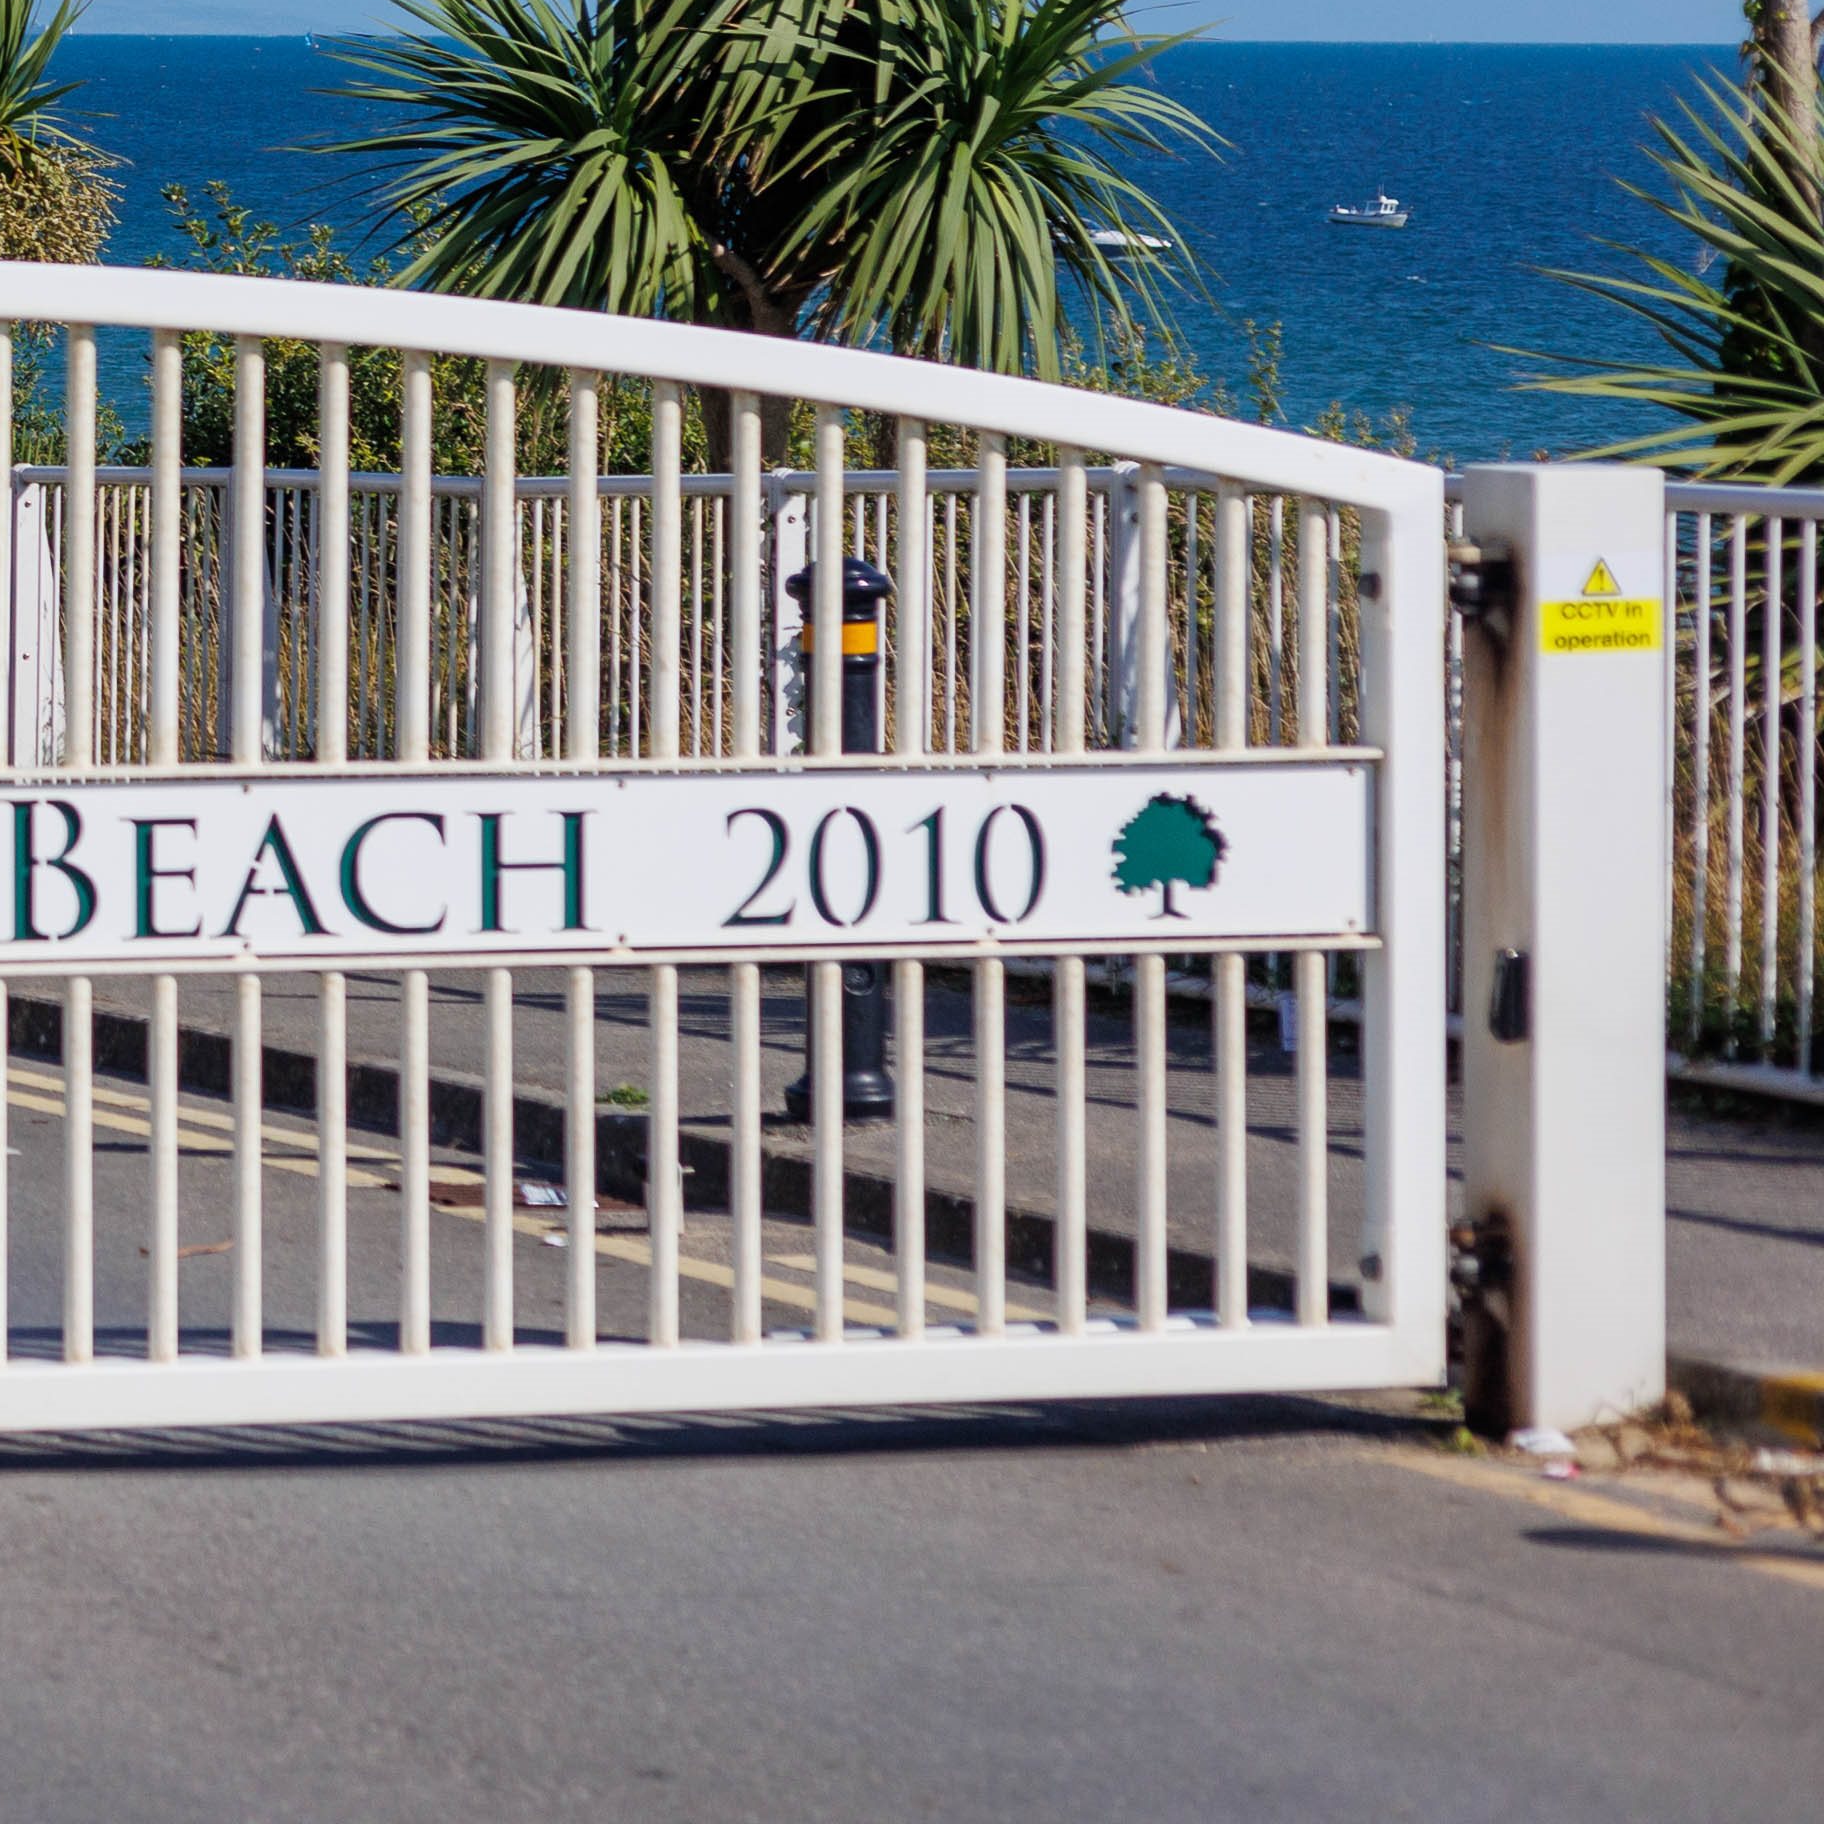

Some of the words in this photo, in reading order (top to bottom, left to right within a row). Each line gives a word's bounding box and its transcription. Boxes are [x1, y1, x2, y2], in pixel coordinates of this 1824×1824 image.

[1561, 602, 1619, 620] CCTV
[1626, 601, 1643, 618] in
[1555, 631, 1651, 651] operation
[720, 802, 1050, 932] 2010
